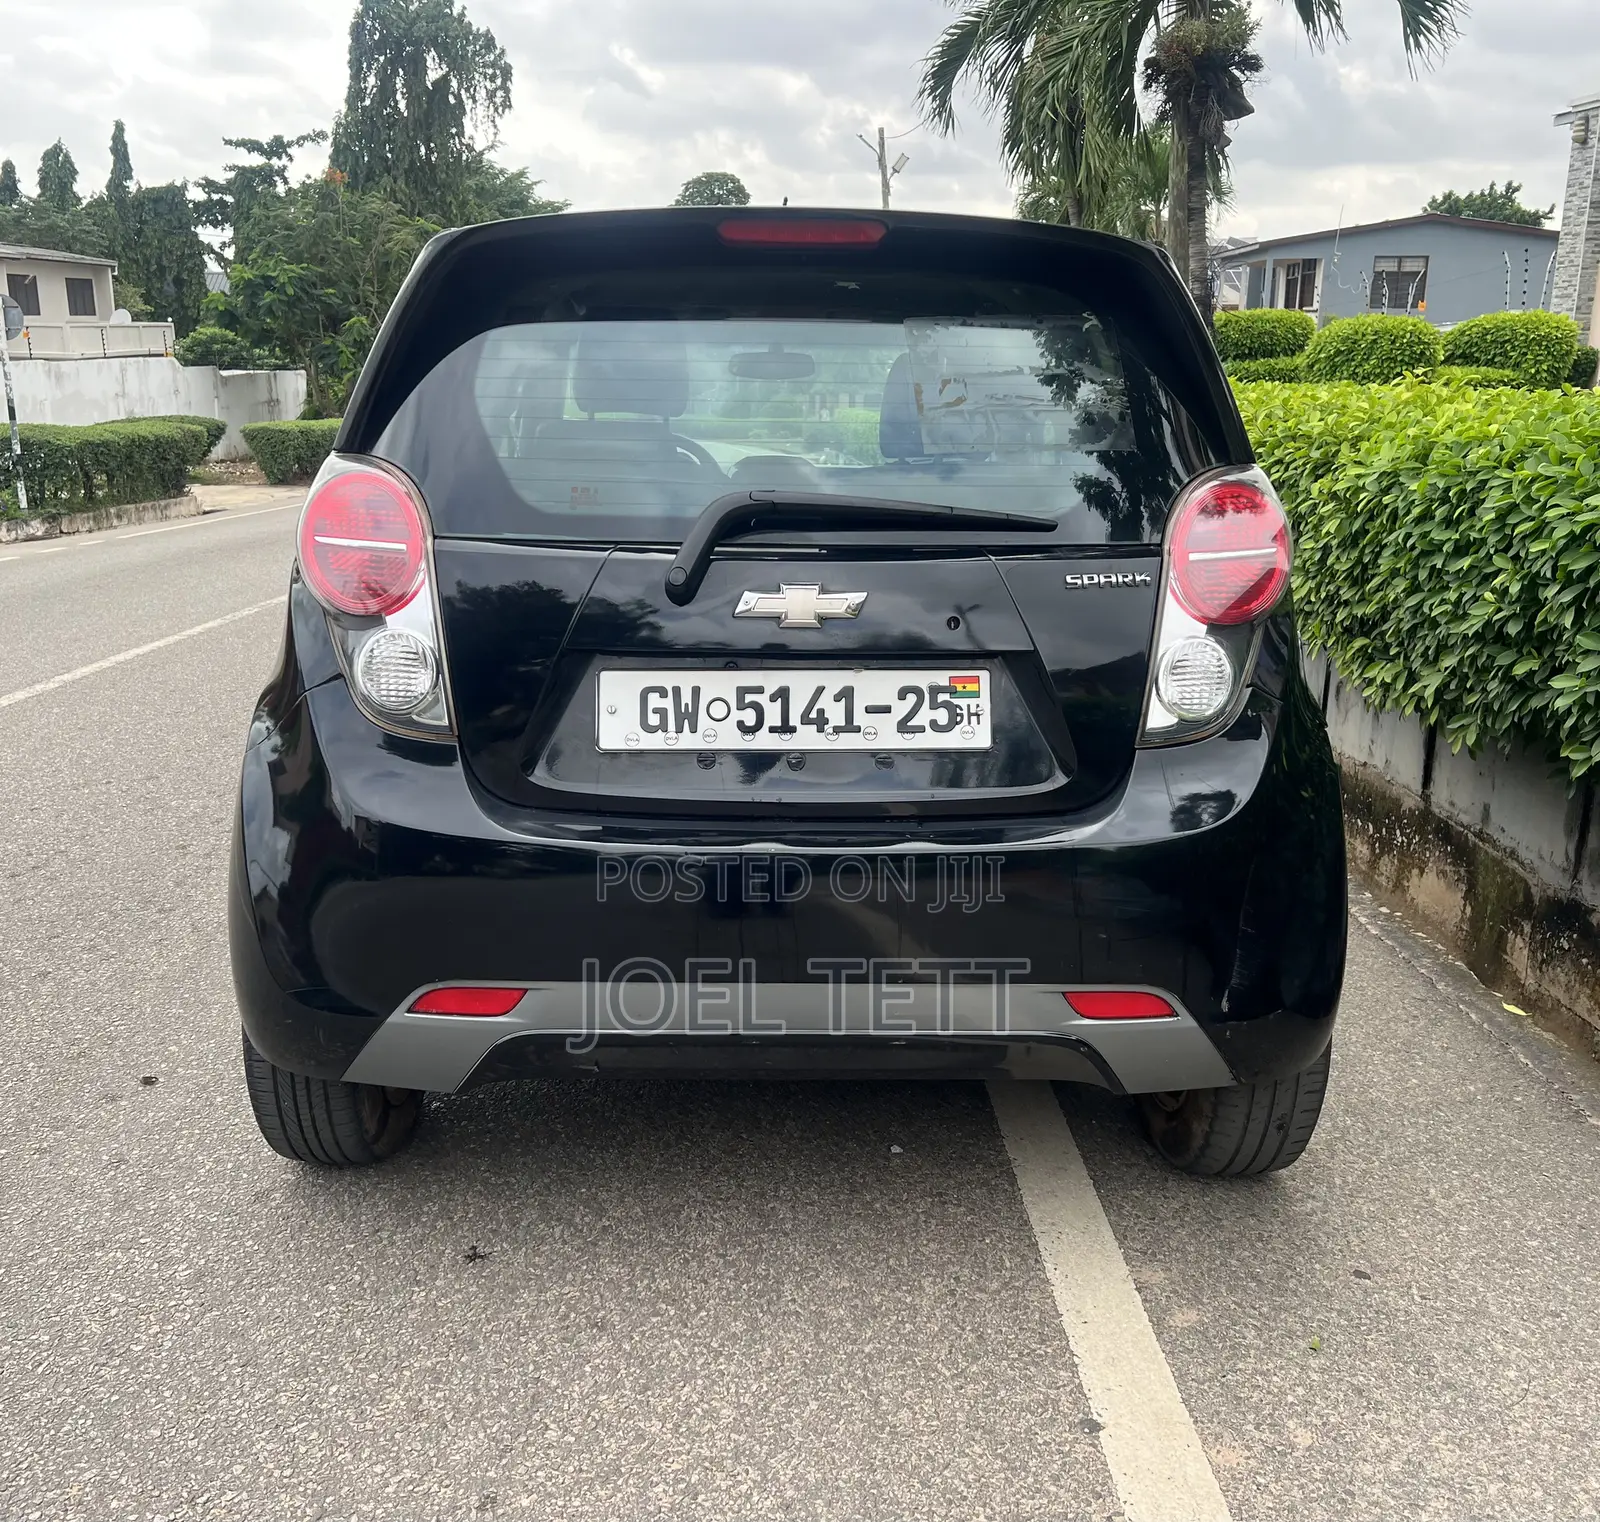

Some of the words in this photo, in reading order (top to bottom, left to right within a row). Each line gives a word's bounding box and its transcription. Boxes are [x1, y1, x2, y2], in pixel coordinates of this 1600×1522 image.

[1065, 572, 1151, 589] SPARK
[639, 685, 701, 733] GW
[736, 685, 958, 733] 5141-25
